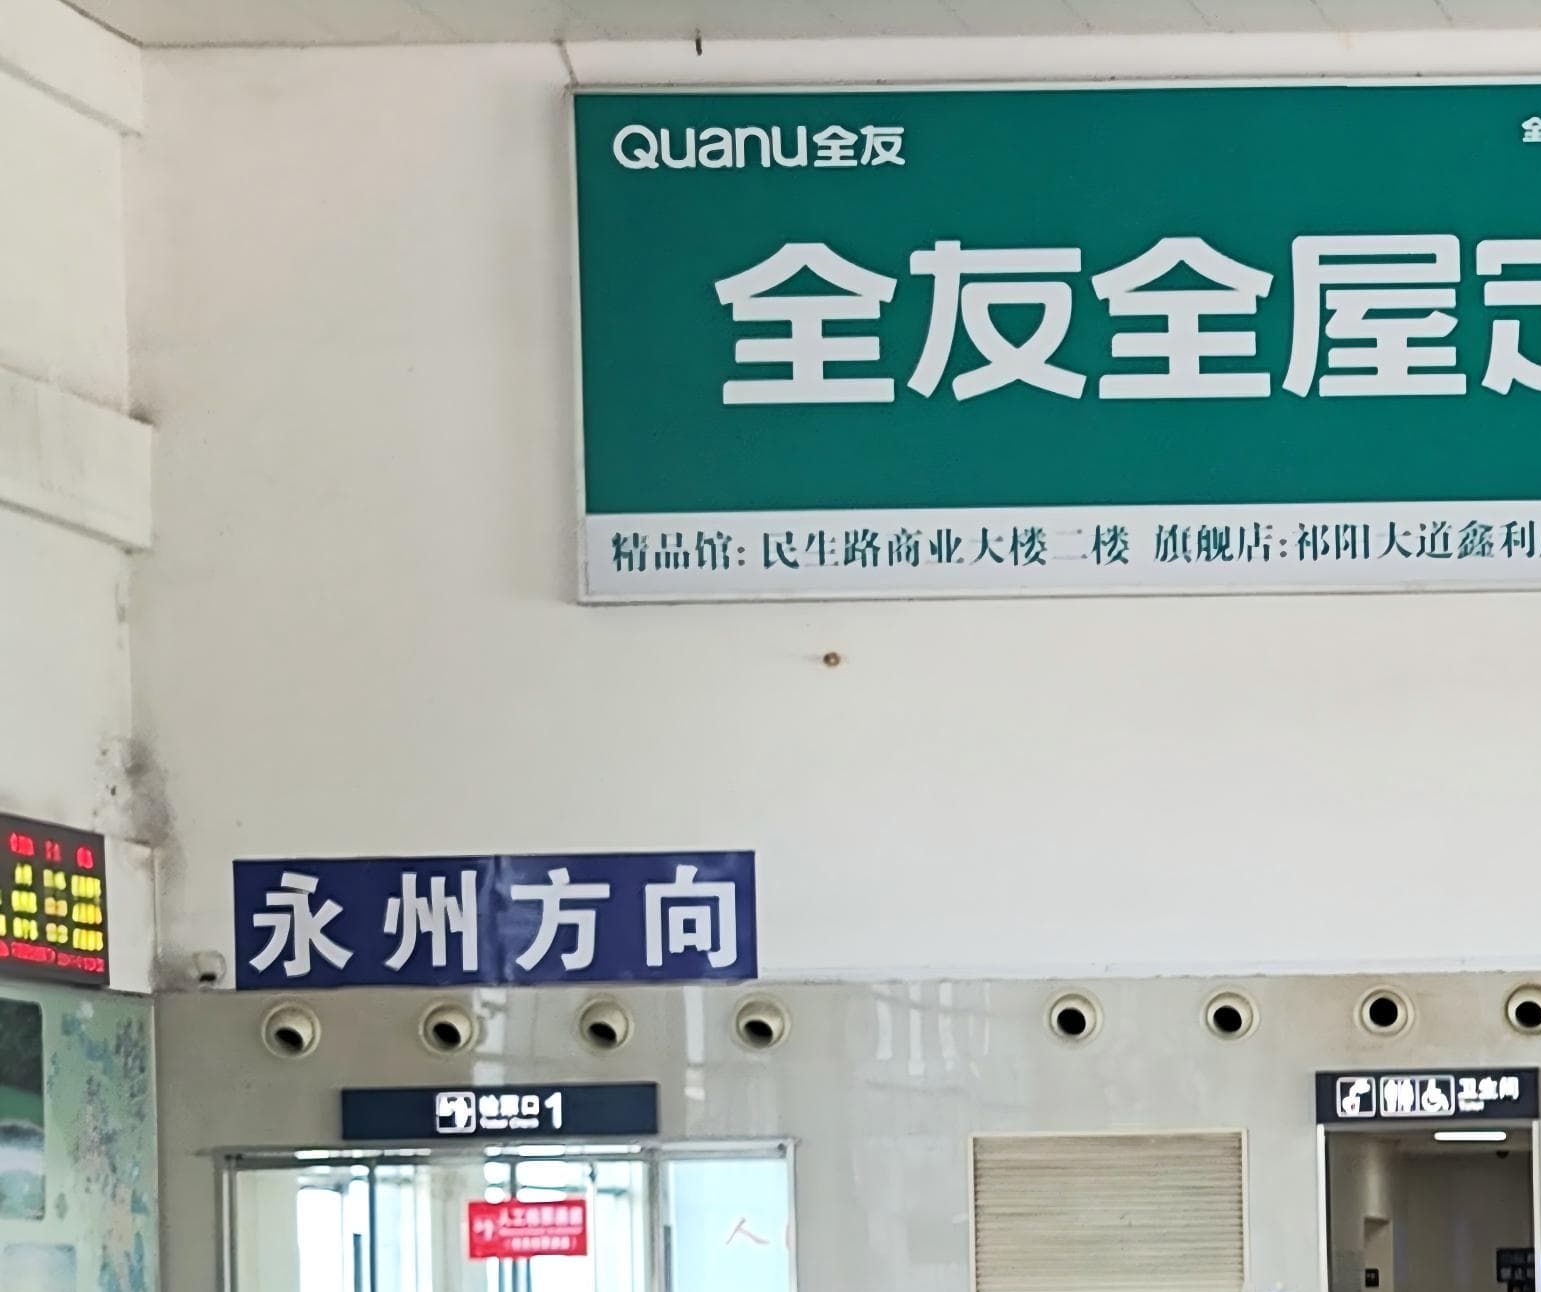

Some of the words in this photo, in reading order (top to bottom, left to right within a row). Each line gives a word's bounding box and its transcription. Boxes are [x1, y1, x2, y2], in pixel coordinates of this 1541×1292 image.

[250, 864, 738, 978] 永州方向
[545, 1091, 564, 1130] 1
